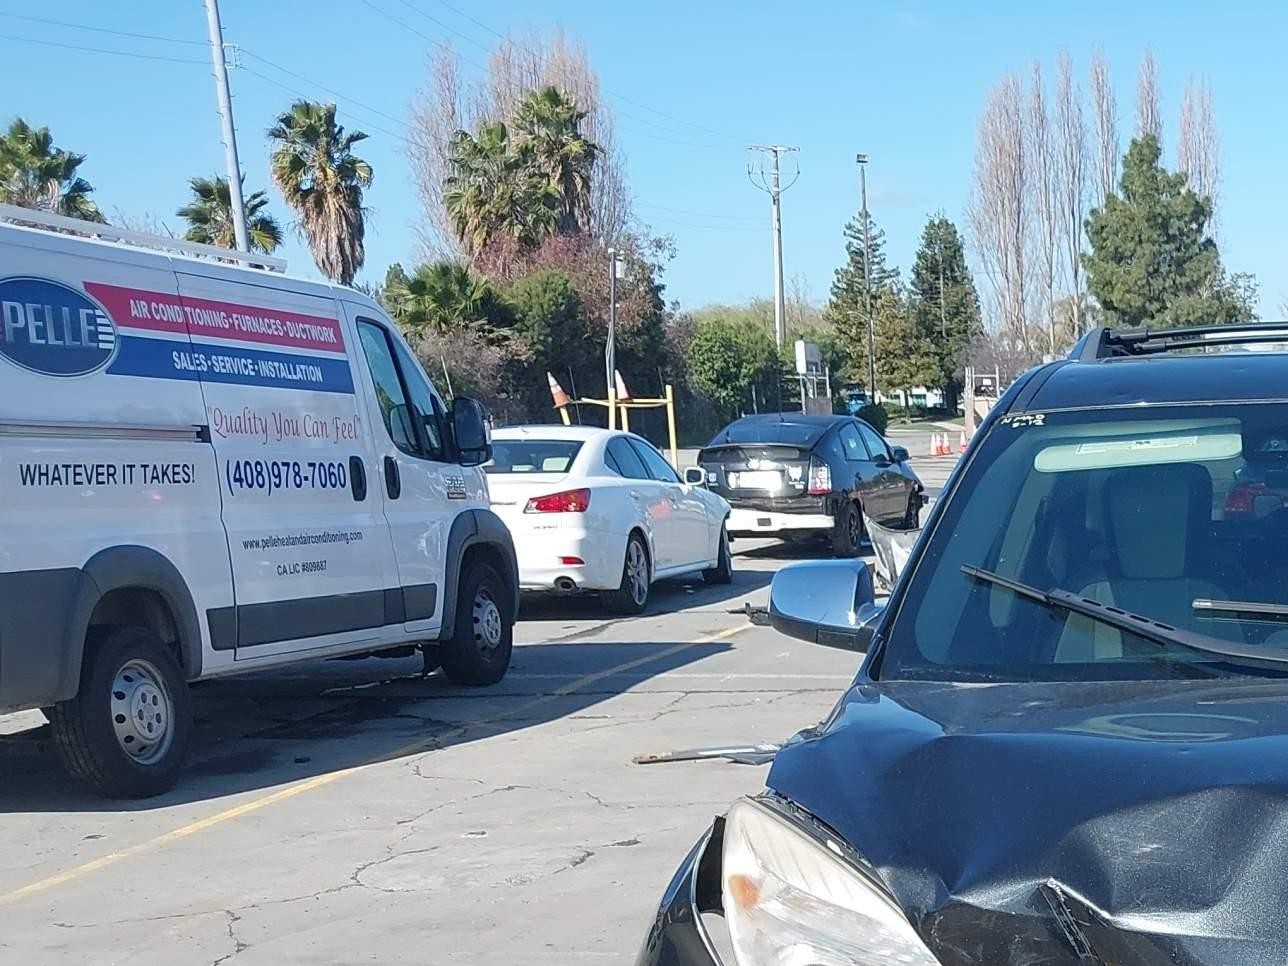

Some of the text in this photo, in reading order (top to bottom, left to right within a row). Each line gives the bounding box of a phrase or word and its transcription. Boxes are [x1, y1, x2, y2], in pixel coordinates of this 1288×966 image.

[129, 299, 151, 320] AIR
[2, 300, 98, 347] PELLE
[271, 411, 301, 442] You
[303, 414, 329, 439] Can
[19, 463, 196, 486] WHATEVER IT TAKES!
[226, 459, 347, 496] (408)978-7060
[242, 531, 363, 551] www.pelleheatandairconditioning.com
[276, 564, 288, 576] CA
[288, 562, 300, 575] LIC
